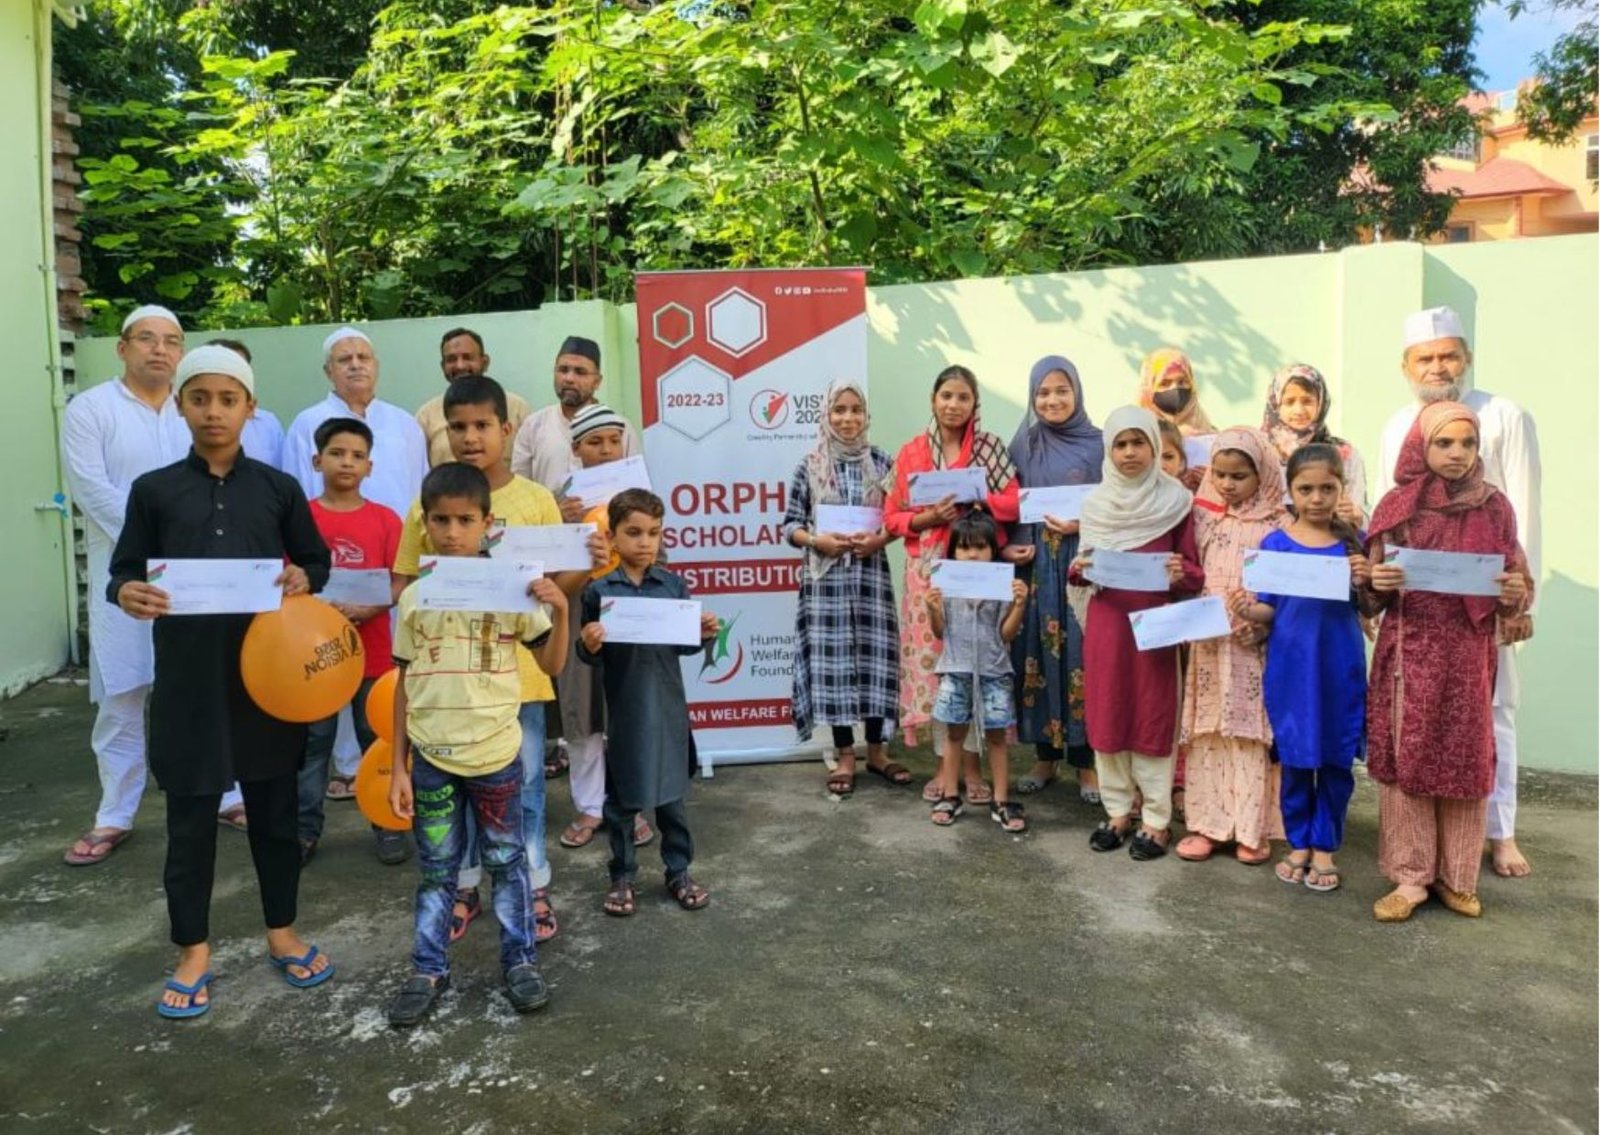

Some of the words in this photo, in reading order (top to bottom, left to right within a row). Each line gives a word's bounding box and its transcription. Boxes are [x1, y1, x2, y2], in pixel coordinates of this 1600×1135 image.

[667, 393, 724, 407] 2022-23
[792, 394, 823, 409] VIS
[671, 481, 785, 516] ORPH
[314, 638, 342, 658] 2026
[303, 649, 349, 675] VISION
[711, 706, 777, 721] WELFARE
[781, 705, 793, 717] F
